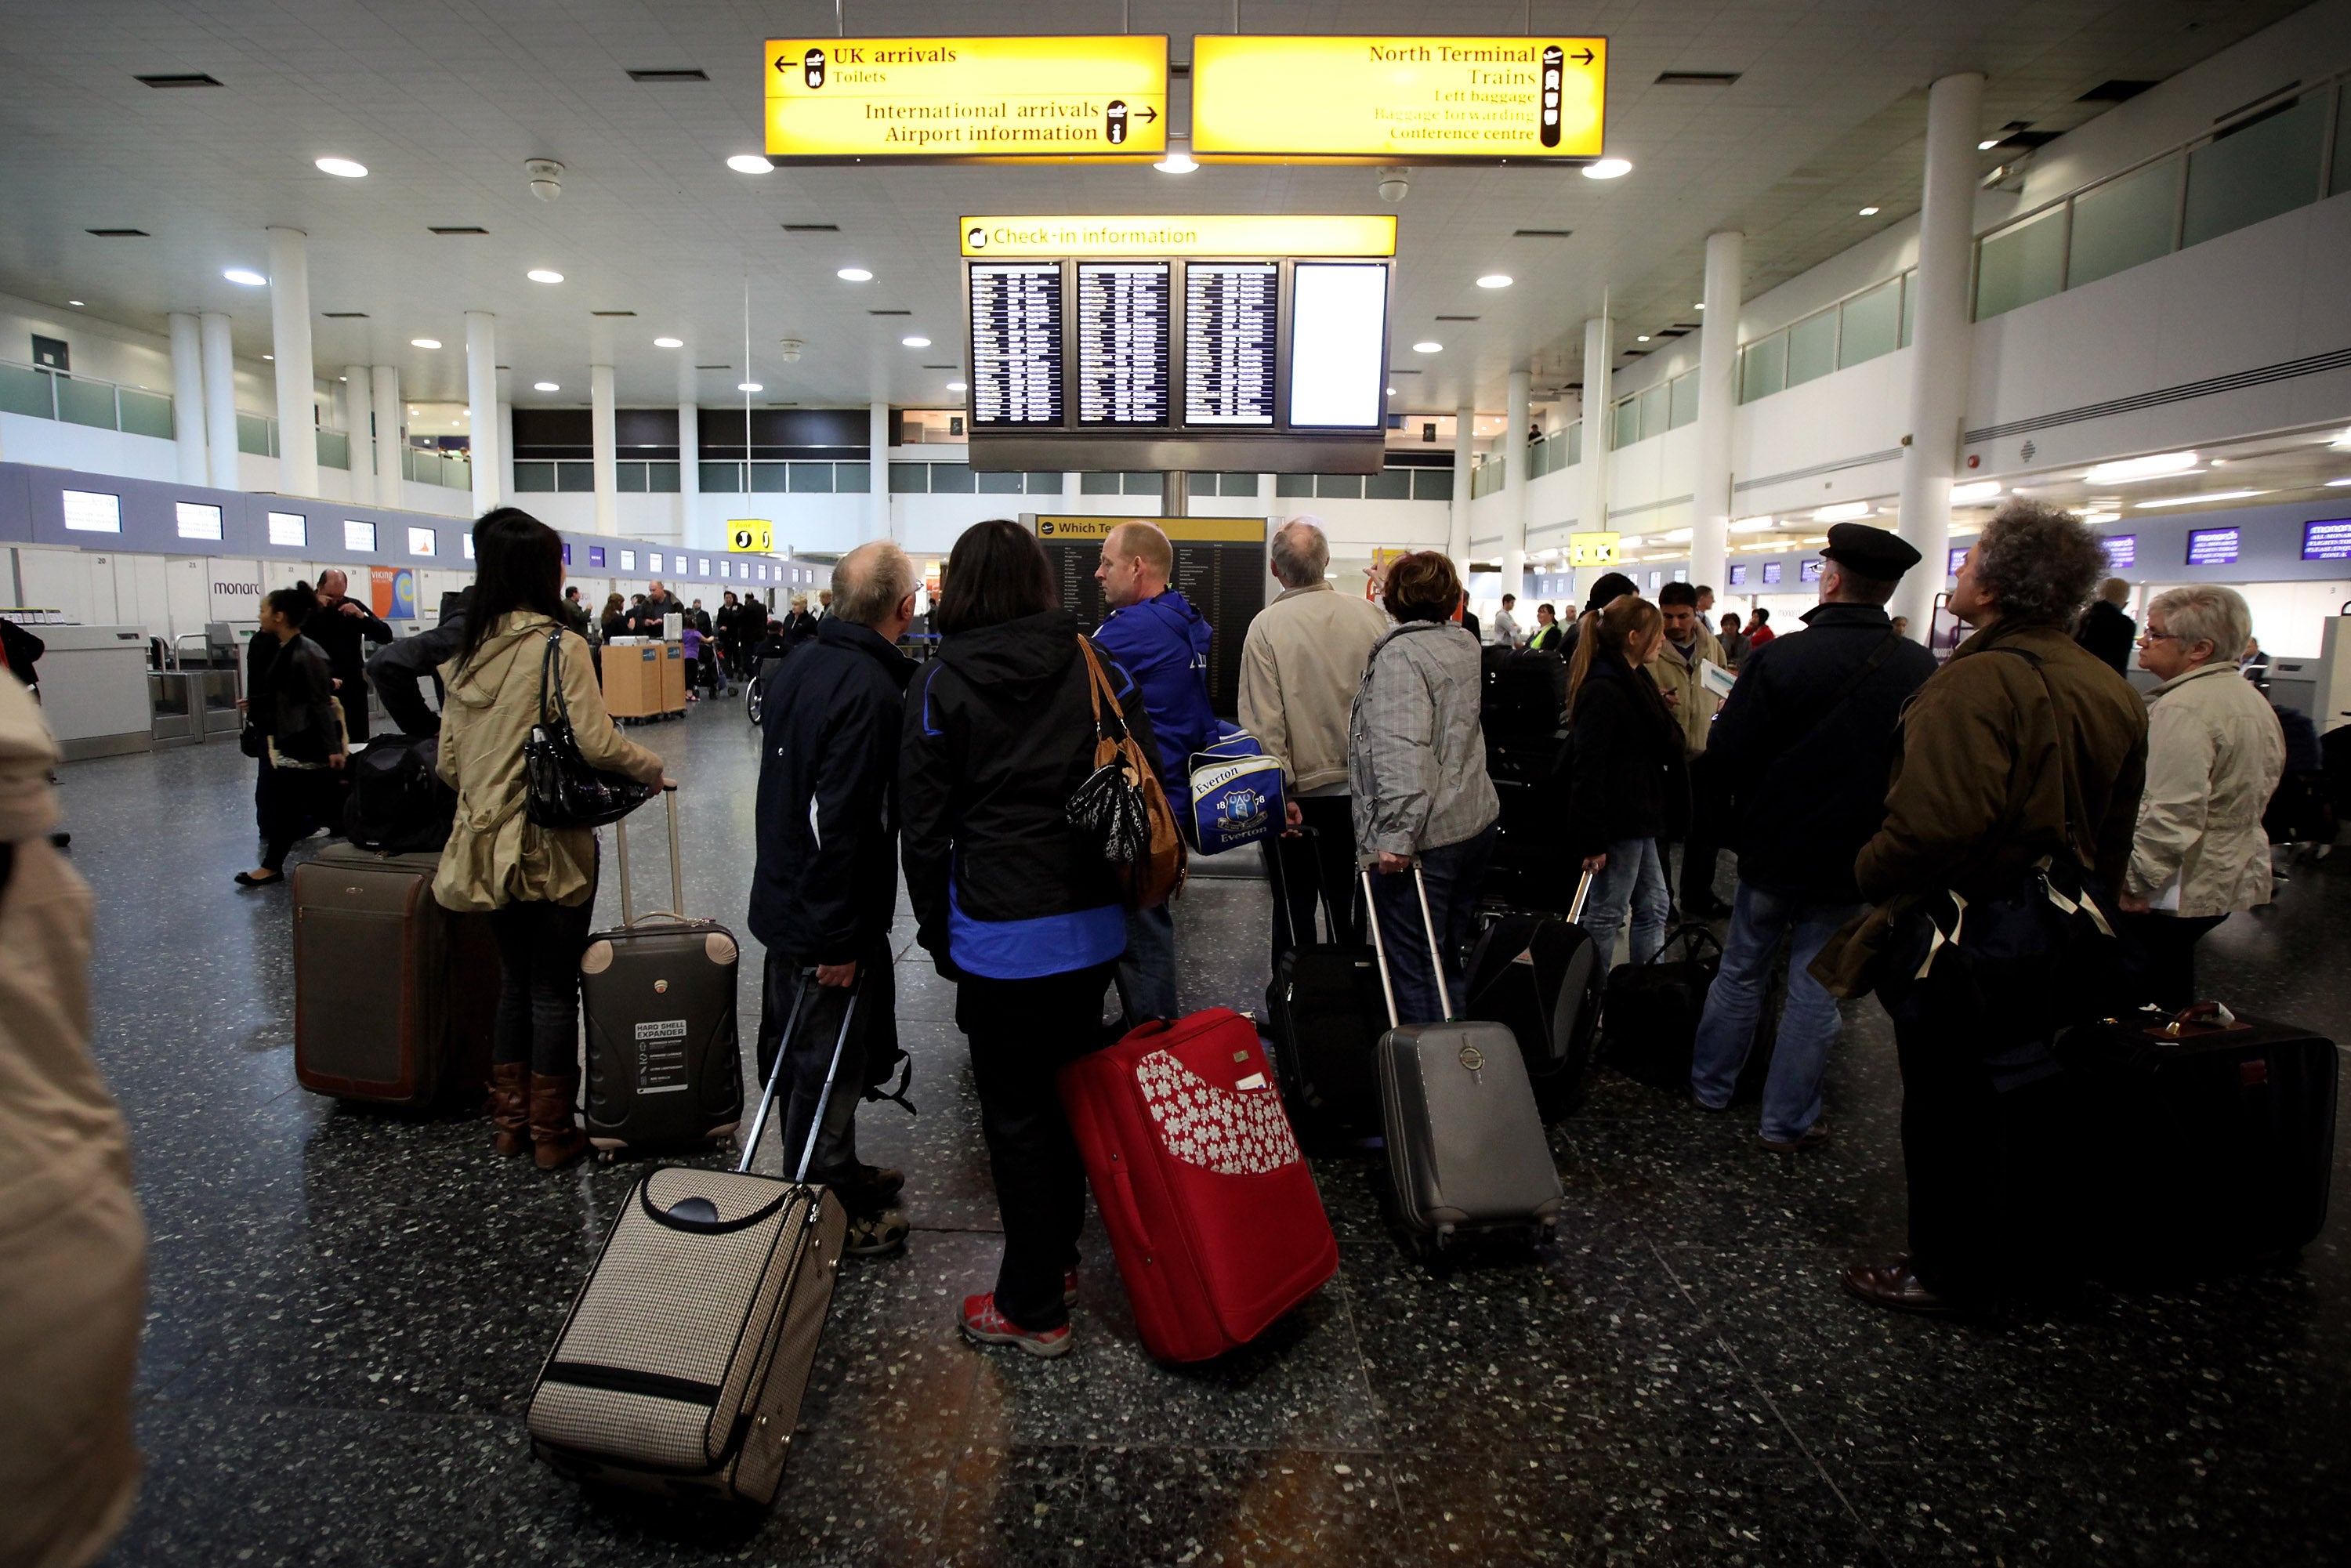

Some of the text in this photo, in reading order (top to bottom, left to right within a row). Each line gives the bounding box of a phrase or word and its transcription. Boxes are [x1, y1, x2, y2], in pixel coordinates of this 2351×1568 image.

[833, 46, 957, 63] UK arrivals
[1369, 45, 1537, 62] North Terminal
[833, 70, 887, 84] Toilets
[1468, 69, 1537, 85] Trains
[1435, 89, 1536, 105] Left baggage
[865, 102, 1099, 120] International arrivals
[1375, 107, 1536, 124] Baggage forwarding
[884, 125, 1098, 146] Airport information
[1390, 126, 1534, 140] Conference centre
[994, 226, 1197, 244] Check-in information
[1059, 522, 1096, 534] Which
[738, 531, 748, 547] J
[1597, 545, 1611, 559] K
[1195, 766, 1239, 795] Everton
[1216, 795, 1265, 810] 18 78
[1221, 827, 1267, 842] Everton
[637, 1029, 684, 1038] EXPANDER
